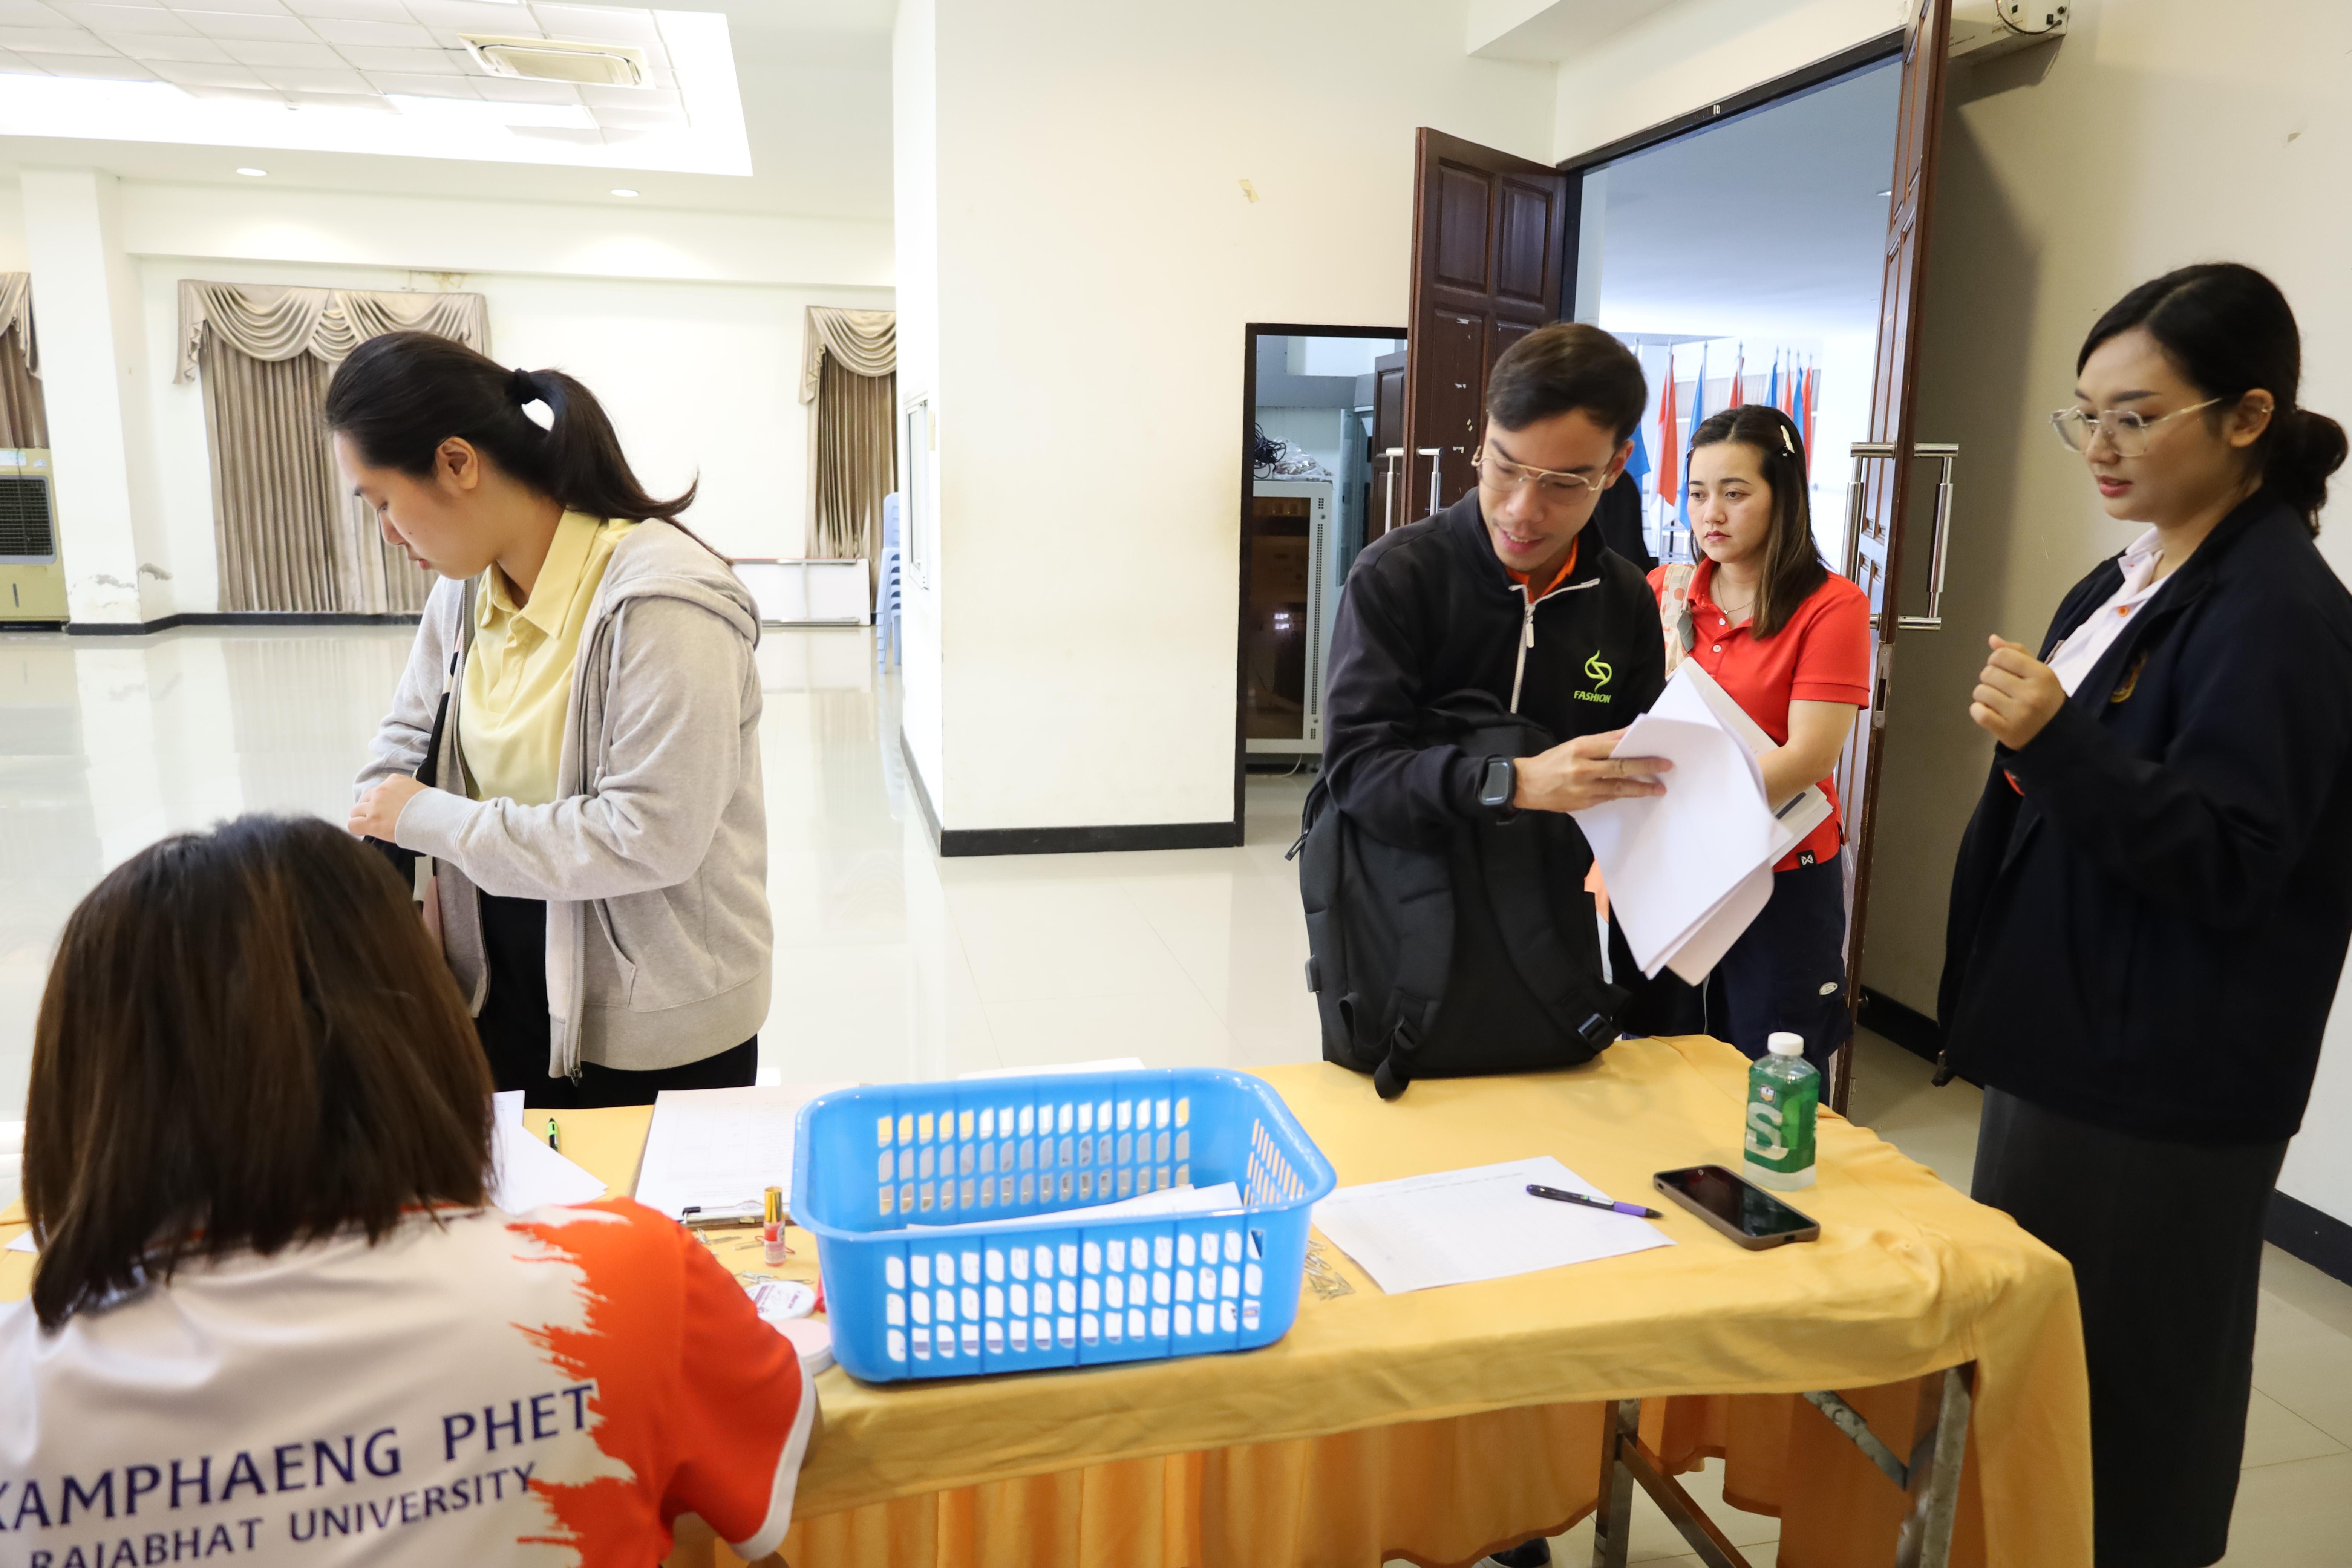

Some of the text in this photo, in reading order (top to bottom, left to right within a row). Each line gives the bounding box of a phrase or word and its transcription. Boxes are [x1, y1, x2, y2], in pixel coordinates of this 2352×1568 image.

[1574, 690, 1611, 703] FASHION
[0, 1383, 594, 1531] AMPHAENG PHET
[290, 1461, 535, 1543] UNIVERSITY
